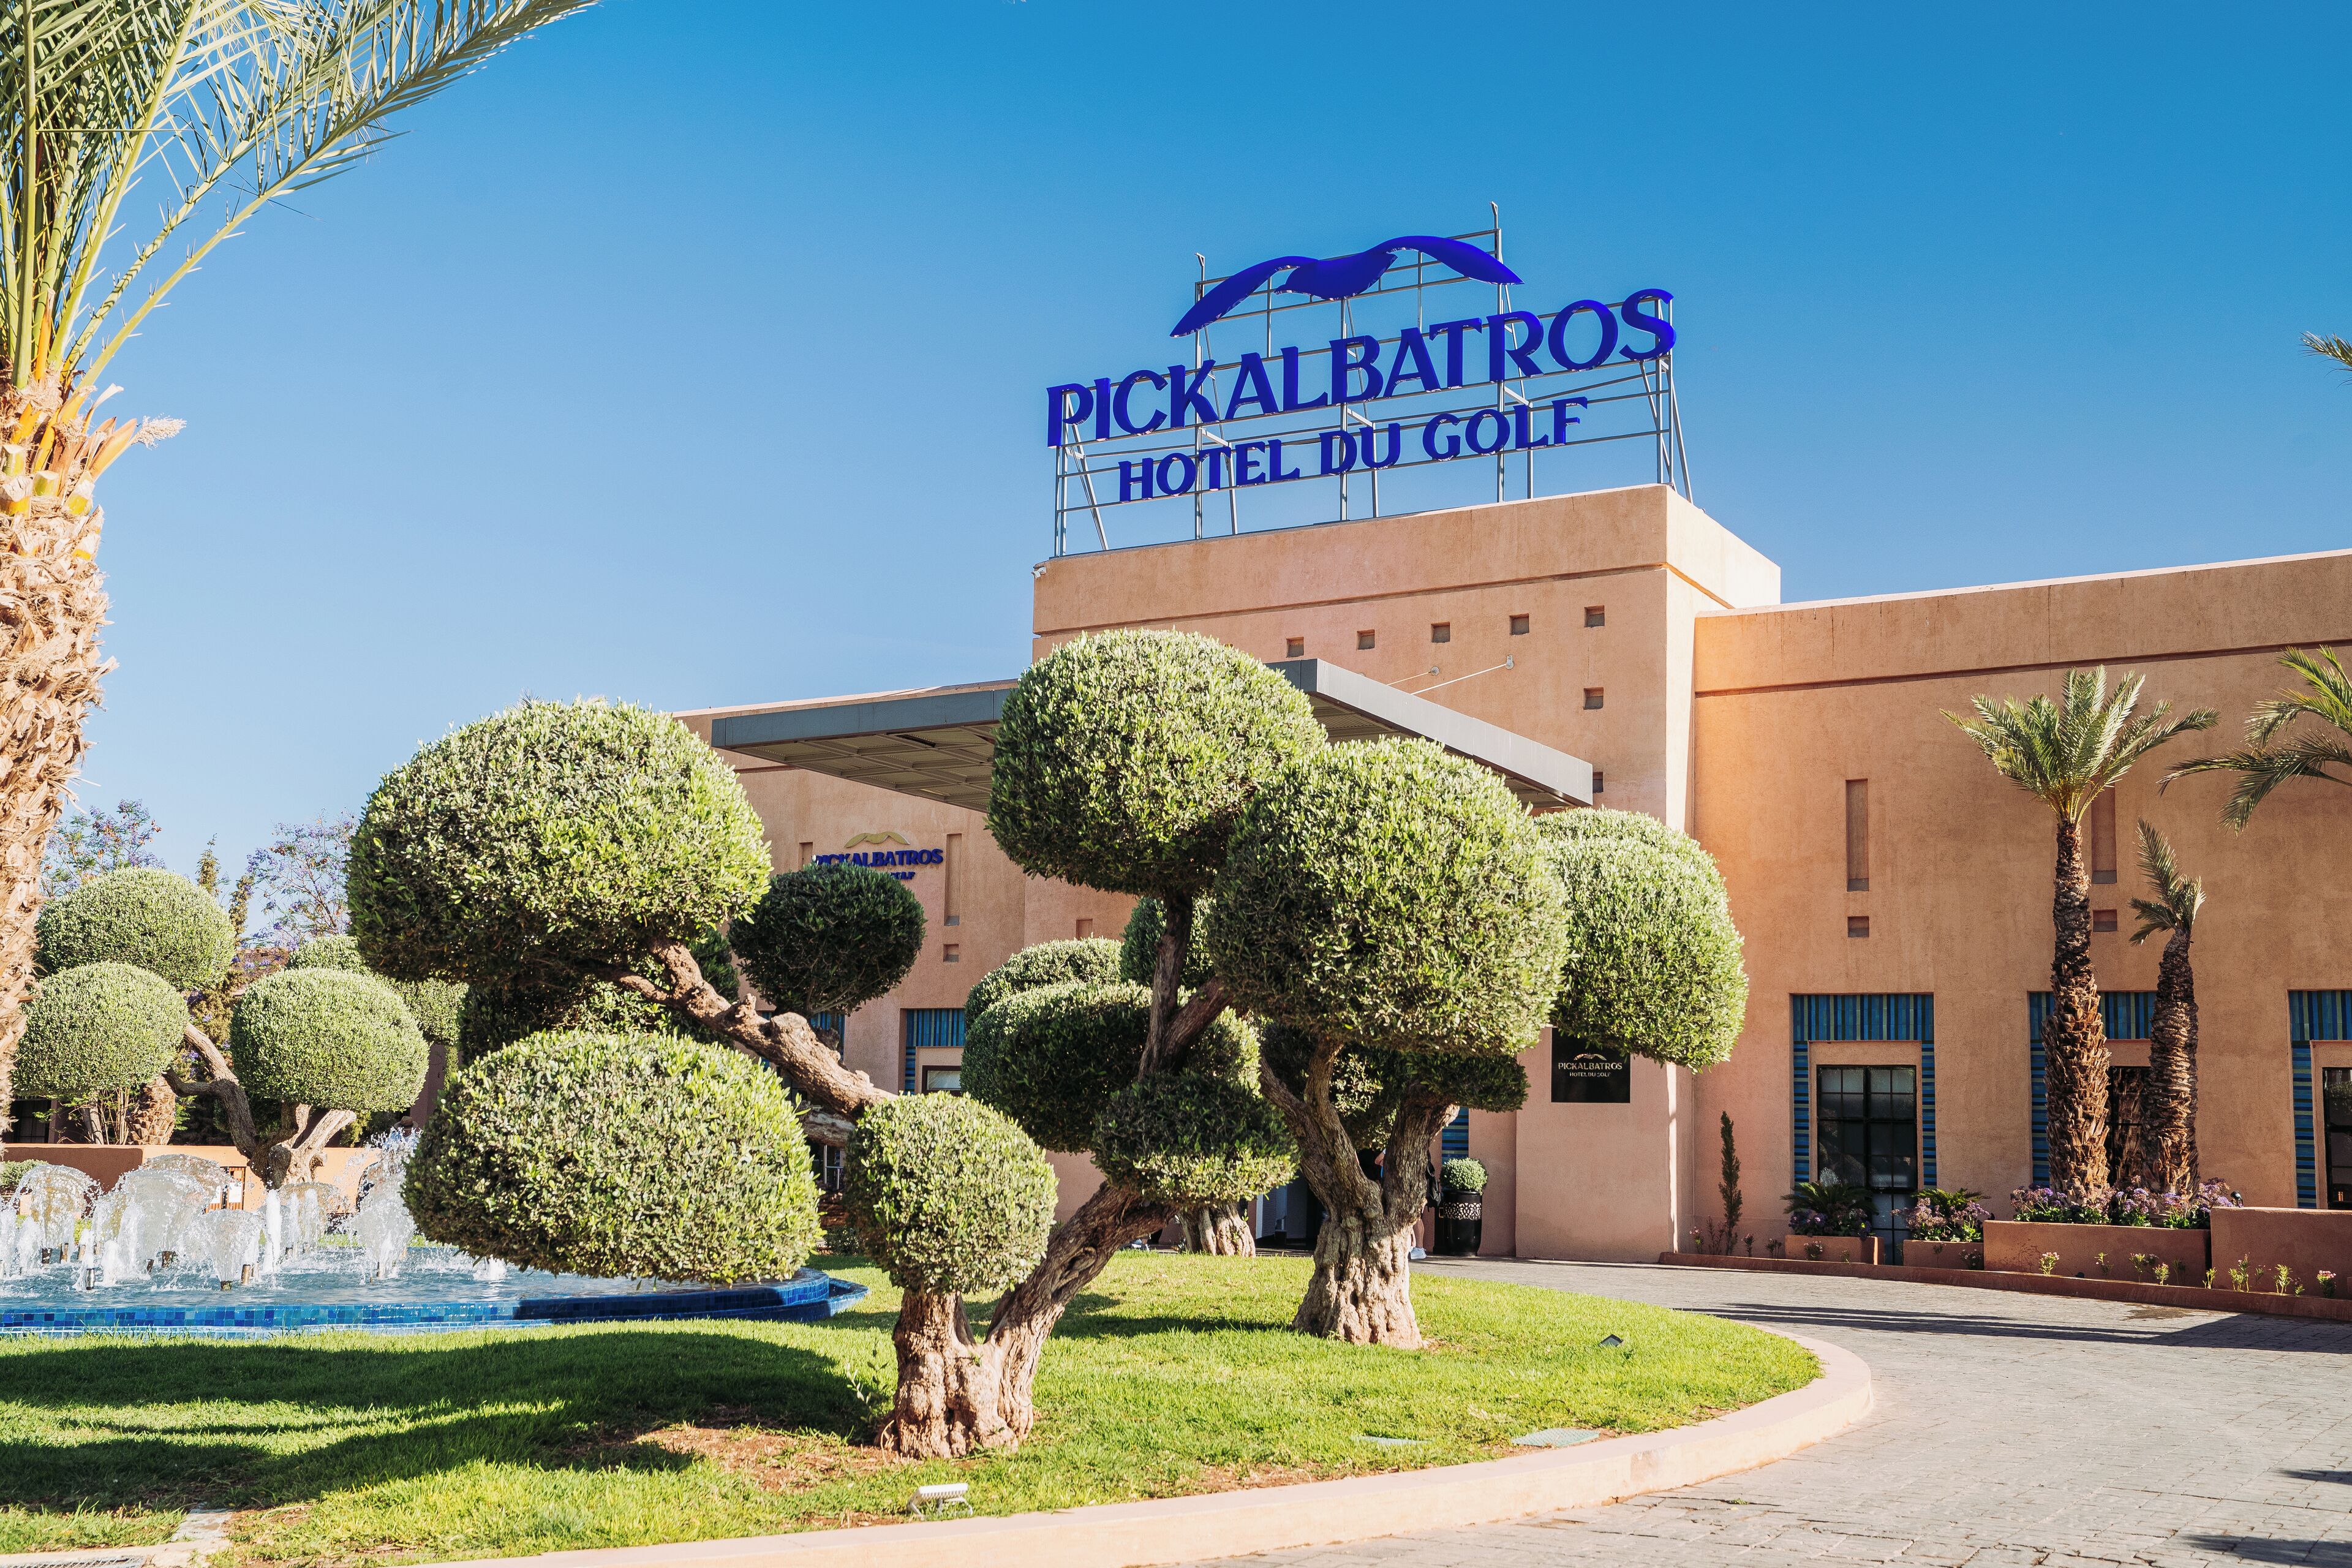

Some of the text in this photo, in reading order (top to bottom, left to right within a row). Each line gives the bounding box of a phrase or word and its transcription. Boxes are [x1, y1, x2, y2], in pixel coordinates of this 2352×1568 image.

[1047, 288, 1677, 448] PICKALBATROS
[1118, 396, 1589, 502] HOTEL DU GOLF
